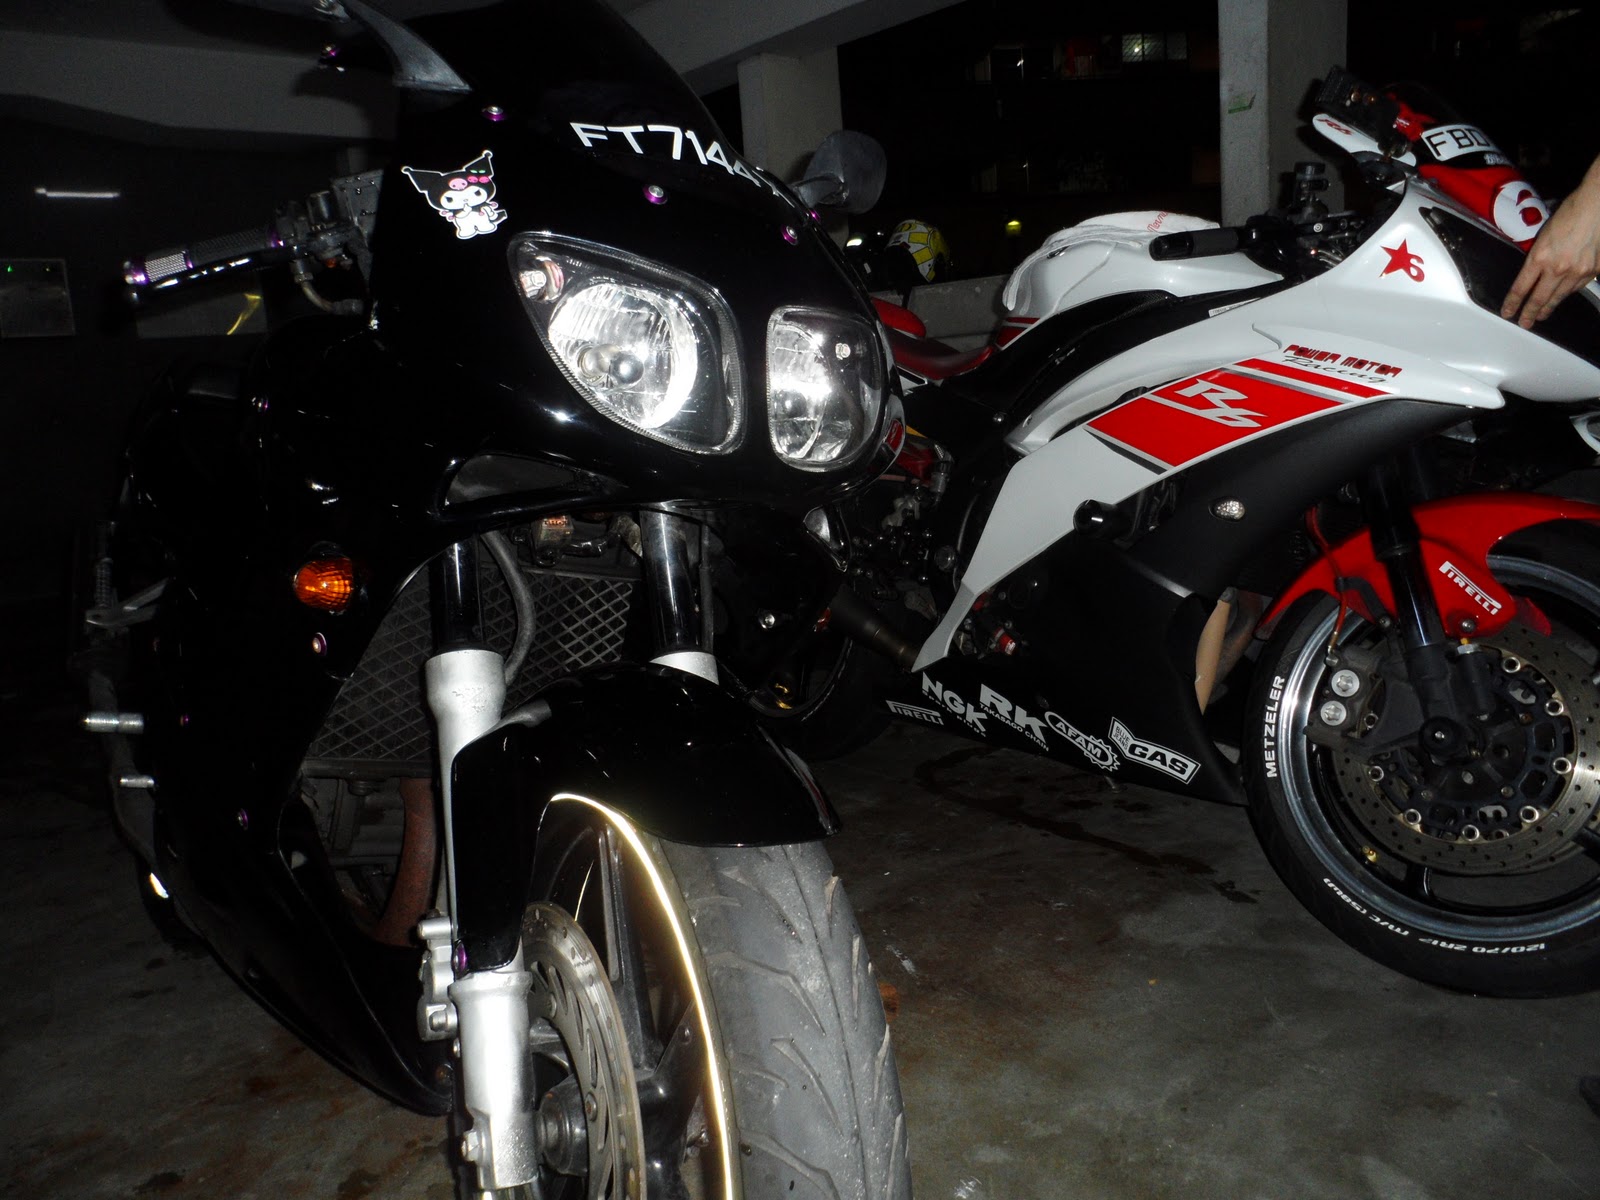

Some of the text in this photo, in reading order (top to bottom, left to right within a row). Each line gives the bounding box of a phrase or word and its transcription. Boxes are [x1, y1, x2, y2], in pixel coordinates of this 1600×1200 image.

[1407, 255, 1426, 283] 6
[1173, 378, 1270, 428] R6
[1438, 560, 1503, 616] PIRELLI
[885, 699, 945, 726] PIRELLI
[921, 671, 989, 733] NGK
[979, 683, 1049, 745] RK
[1263, 675, 1286, 779] METZELER
[979, 702, 1024, 733] TAKASAGO
[1024, 730, 1050, 753] CHAIN
[1055, 720, 1102, 760] AFAM
[1128, 743, 1190, 776] GAS
[1471, 942, 1547, 955] 120/70
